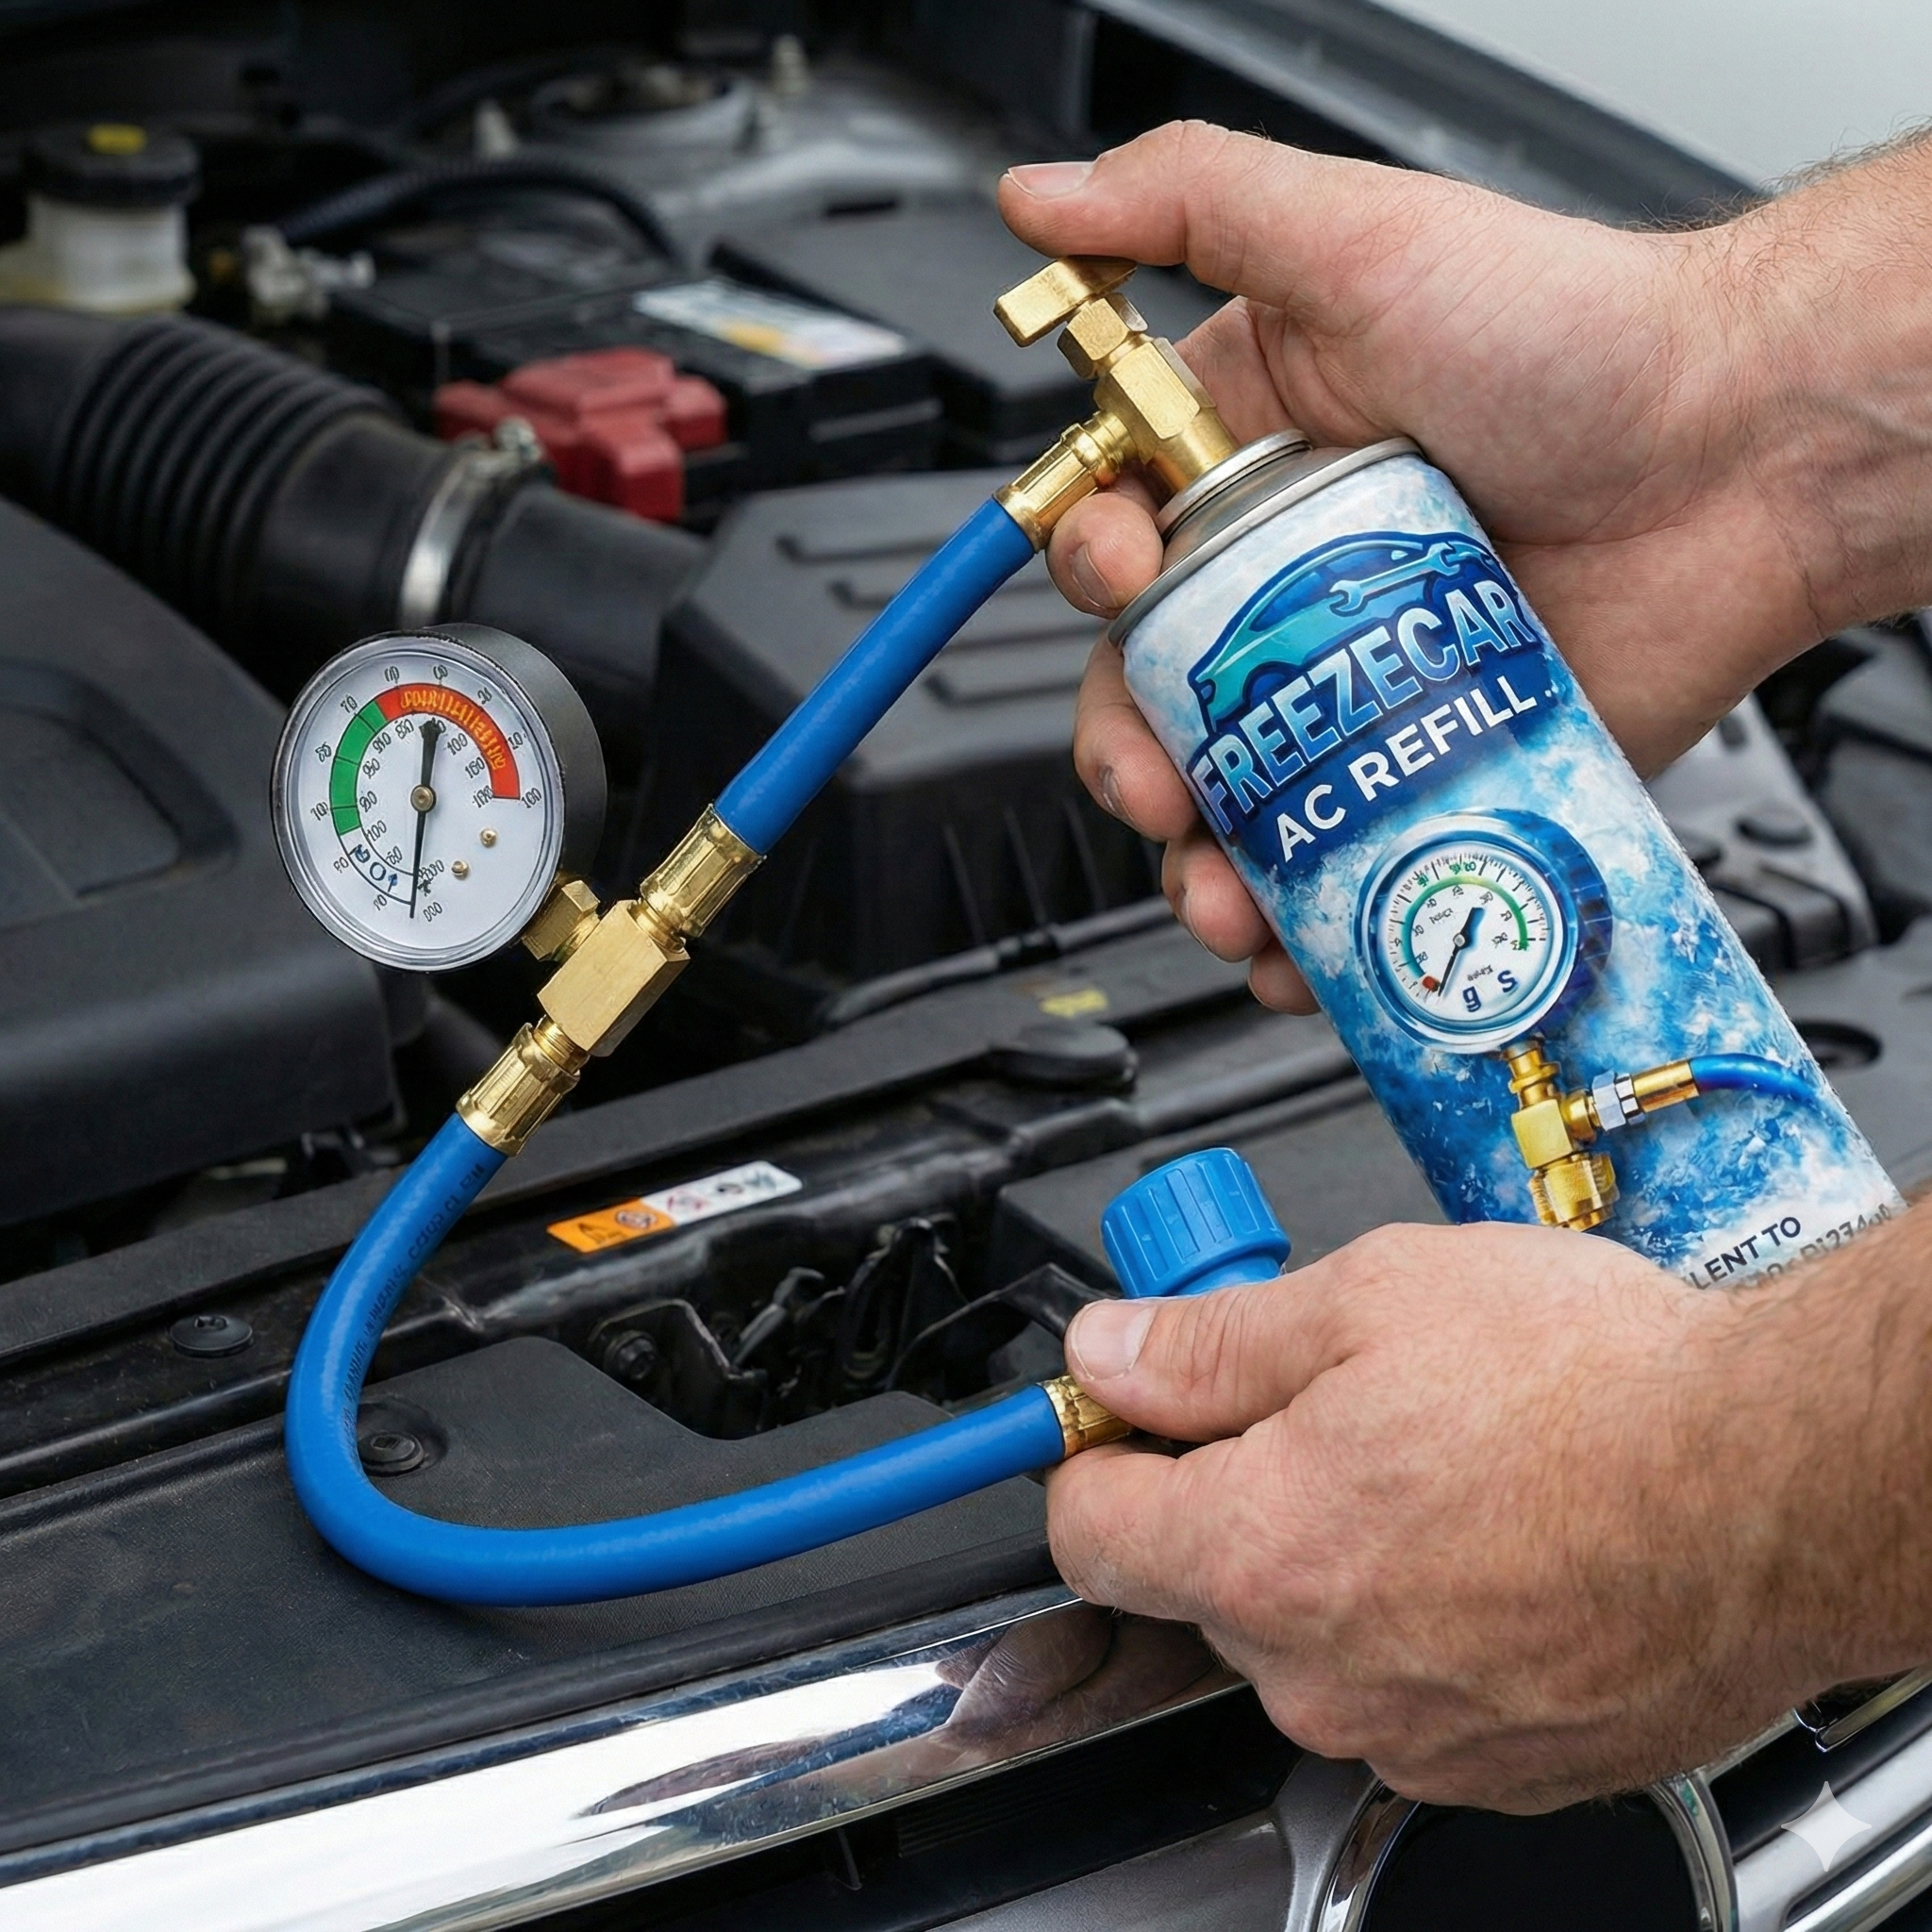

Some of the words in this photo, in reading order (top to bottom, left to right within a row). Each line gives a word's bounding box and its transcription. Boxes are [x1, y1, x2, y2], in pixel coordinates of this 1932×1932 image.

[1189, 578, 1541, 838] FREEZECAR
[1274, 784, 1347, 864] AC
[1347, 675, 1538, 803] REFILL
[1681, 1234, 1759, 1291] LENT
[1760, 1215, 1802, 1248] TO
